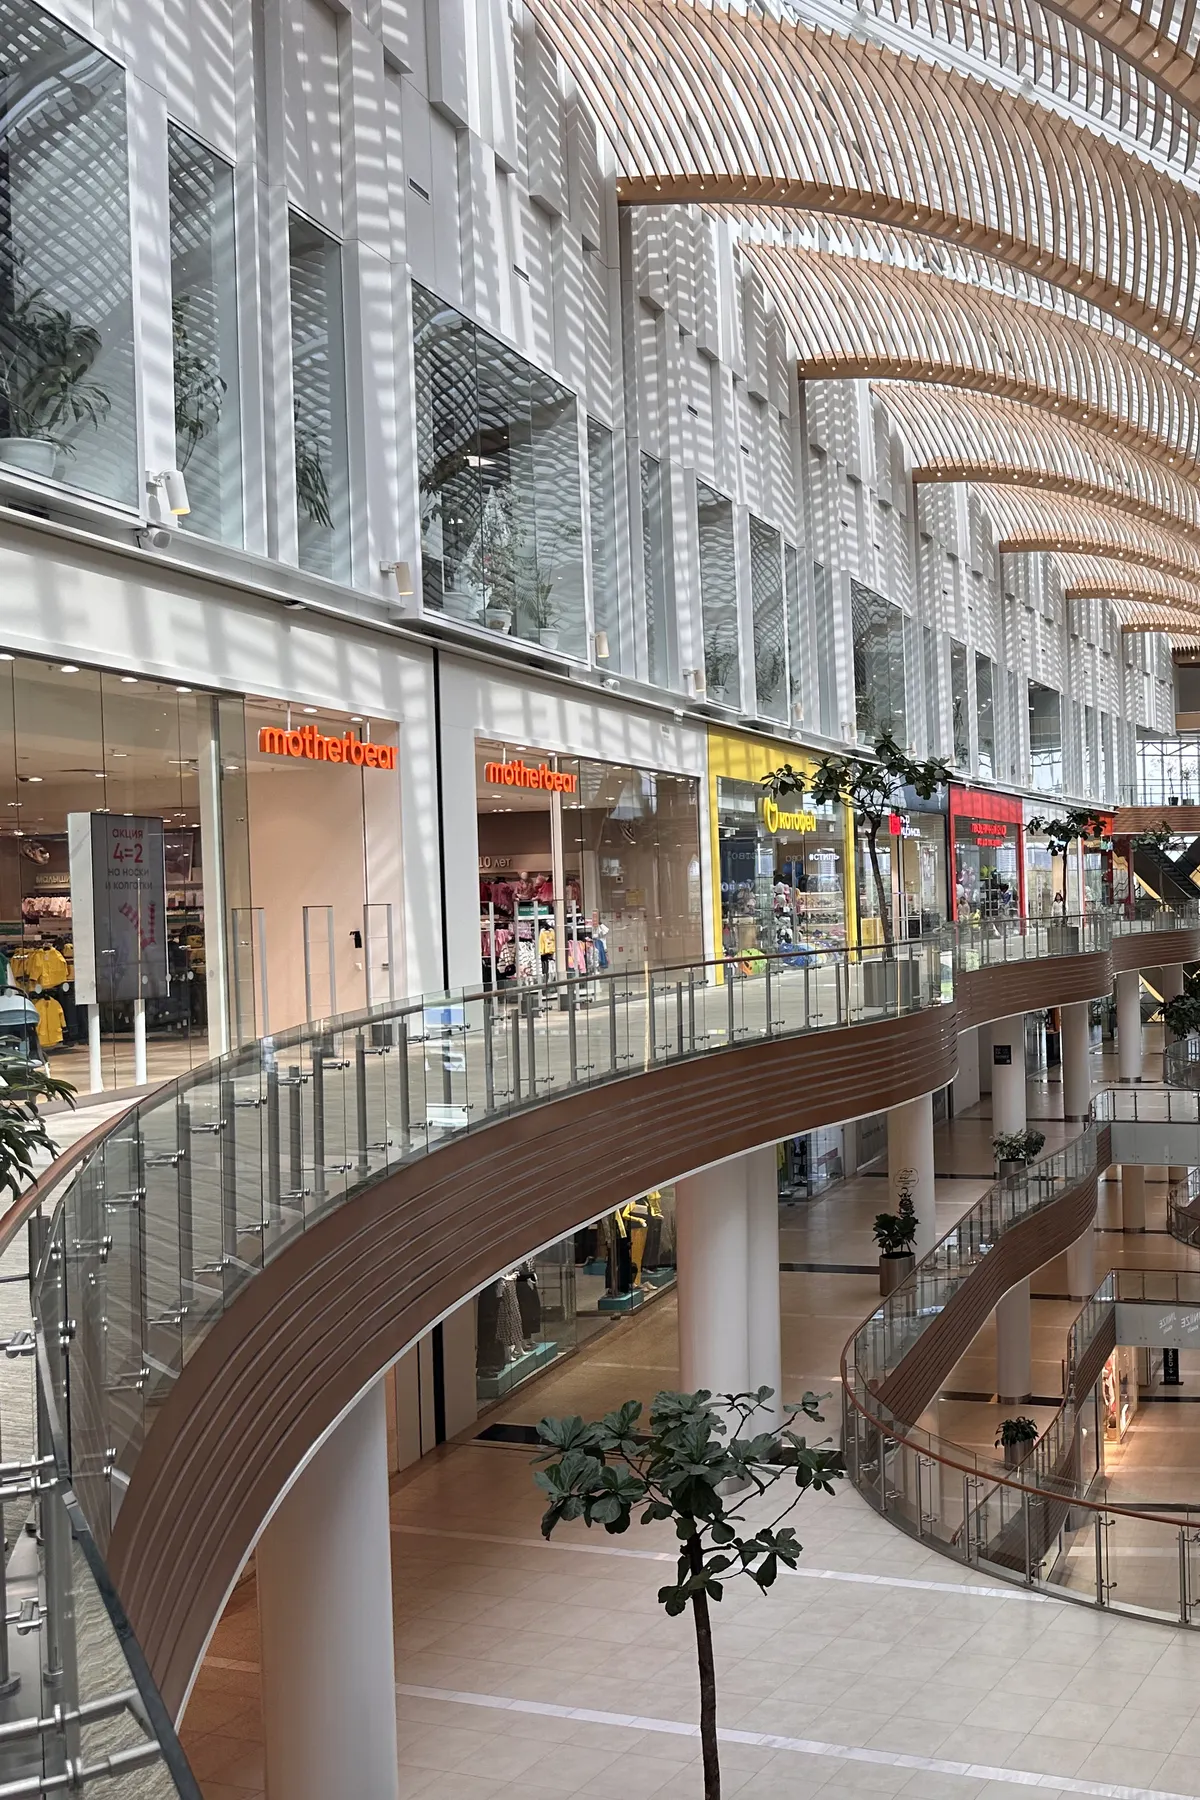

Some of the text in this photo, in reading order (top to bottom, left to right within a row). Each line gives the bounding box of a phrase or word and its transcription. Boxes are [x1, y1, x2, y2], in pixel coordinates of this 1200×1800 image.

[257, 725, 399, 771] motherbear
[484, 760, 578, 793] motherbear
[779, 810, 817, 835] котофей
[112, 828, 144, 840] акция
[113, 843, 144, 863] 4=2
[494, 858, 511, 868] лет
[108, 867, 149, 877] на носки
[113, 881, 153, 891] колготки
